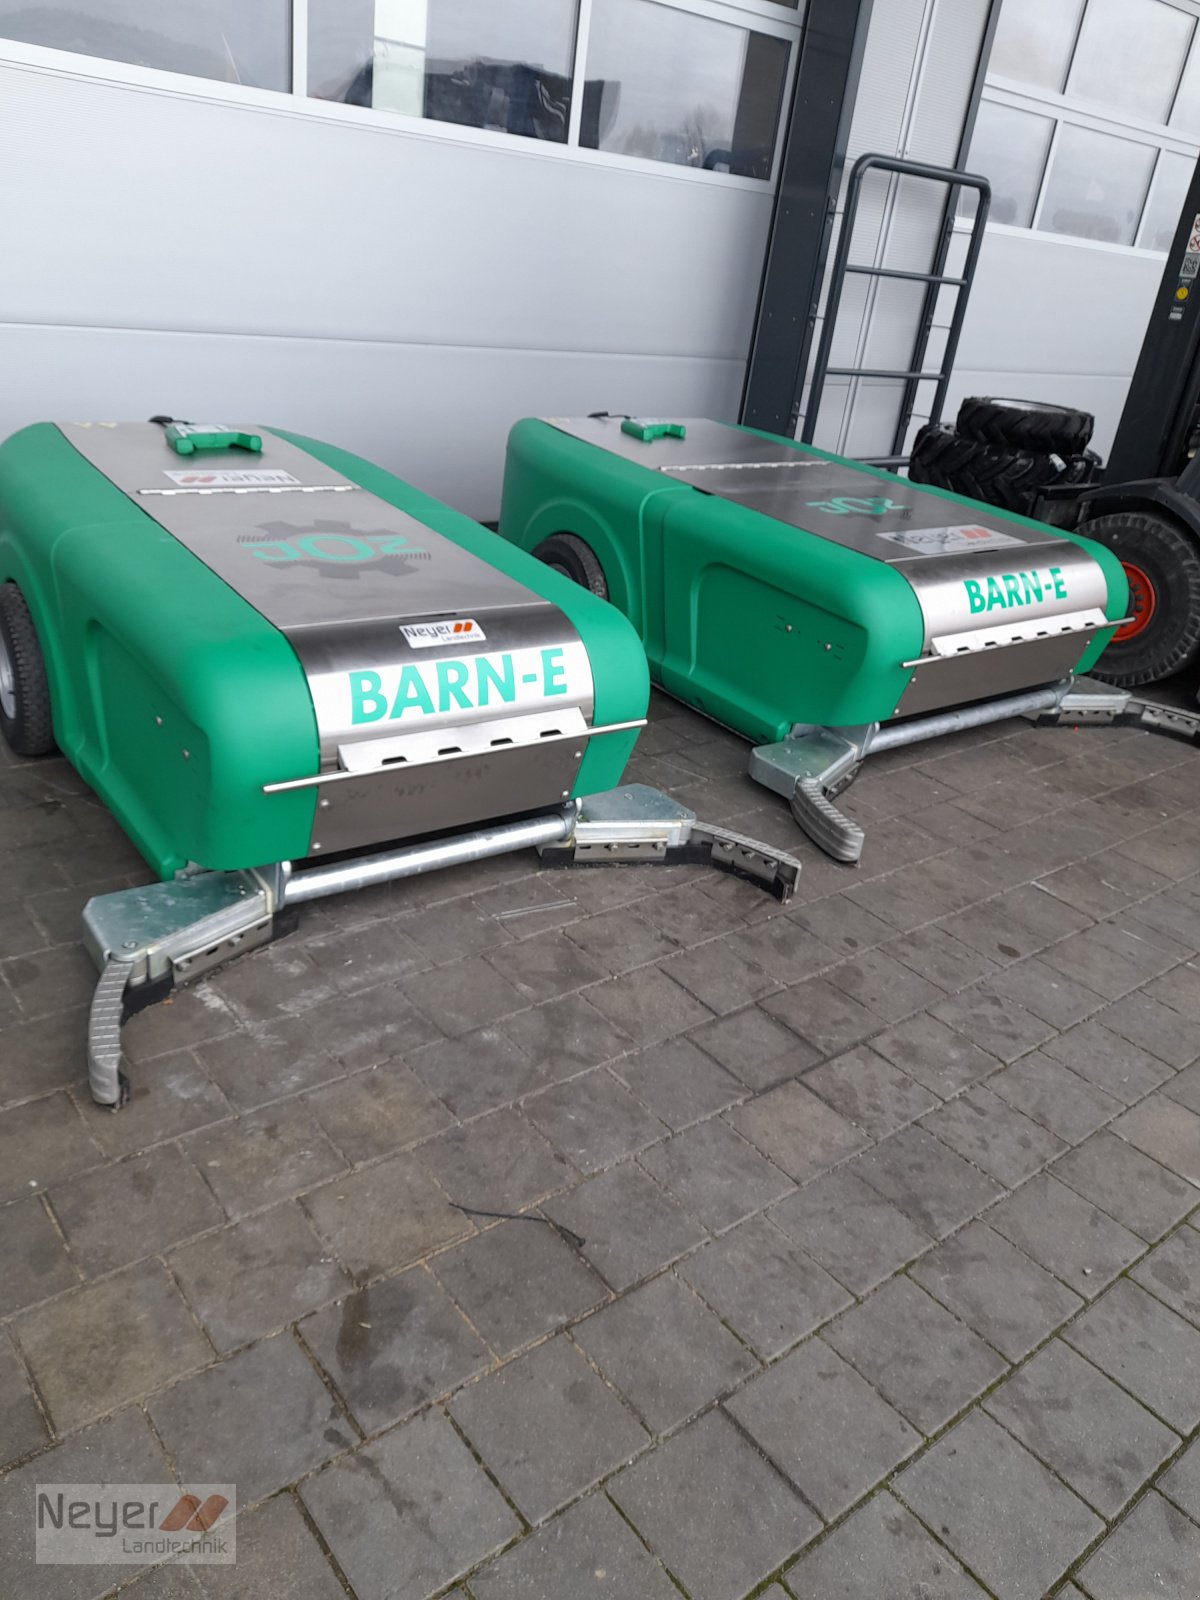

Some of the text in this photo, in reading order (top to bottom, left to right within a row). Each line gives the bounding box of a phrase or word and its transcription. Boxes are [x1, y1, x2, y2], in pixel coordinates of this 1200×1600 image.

[963, 567, 1068, 614] BARN-E
[402, 625, 452, 639] Neyer
[348, 647, 568, 726] BARN-E
